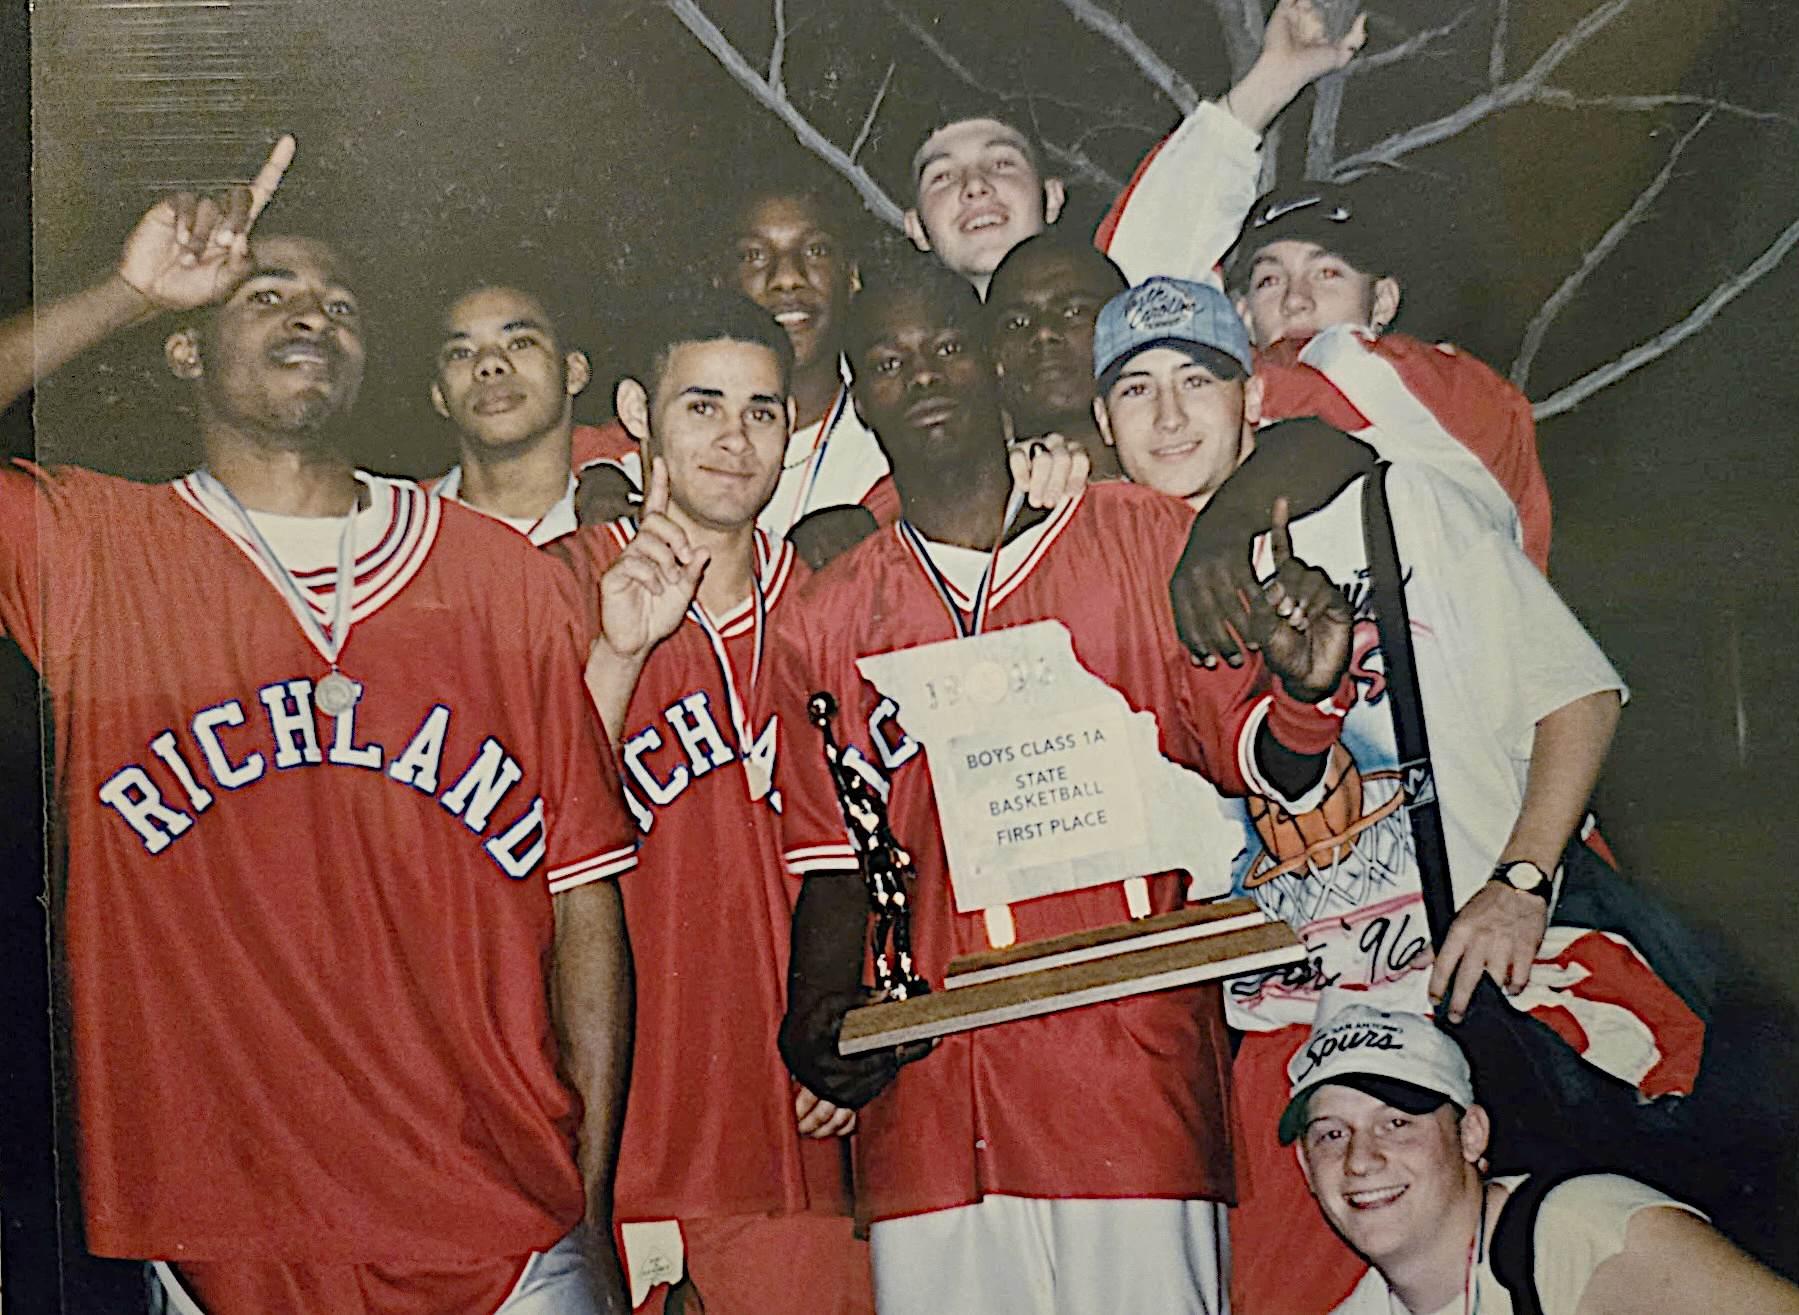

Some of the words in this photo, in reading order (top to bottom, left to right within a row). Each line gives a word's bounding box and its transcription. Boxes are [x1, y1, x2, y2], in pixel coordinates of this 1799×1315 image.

[966, 748, 1015, 769] BOYS
[1020, 735, 1076, 759] CLASS
[1083, 729, 1106, 747] 1A
[98, 678, 548, 881] RICHLAND
[1015, 766, 1067, 789] STATE
[989, 783, 1104, 816] BASKETBALL
[996, 822, 1044, 845] FIRST
[1050, 810, 1108, 834] PLACE
